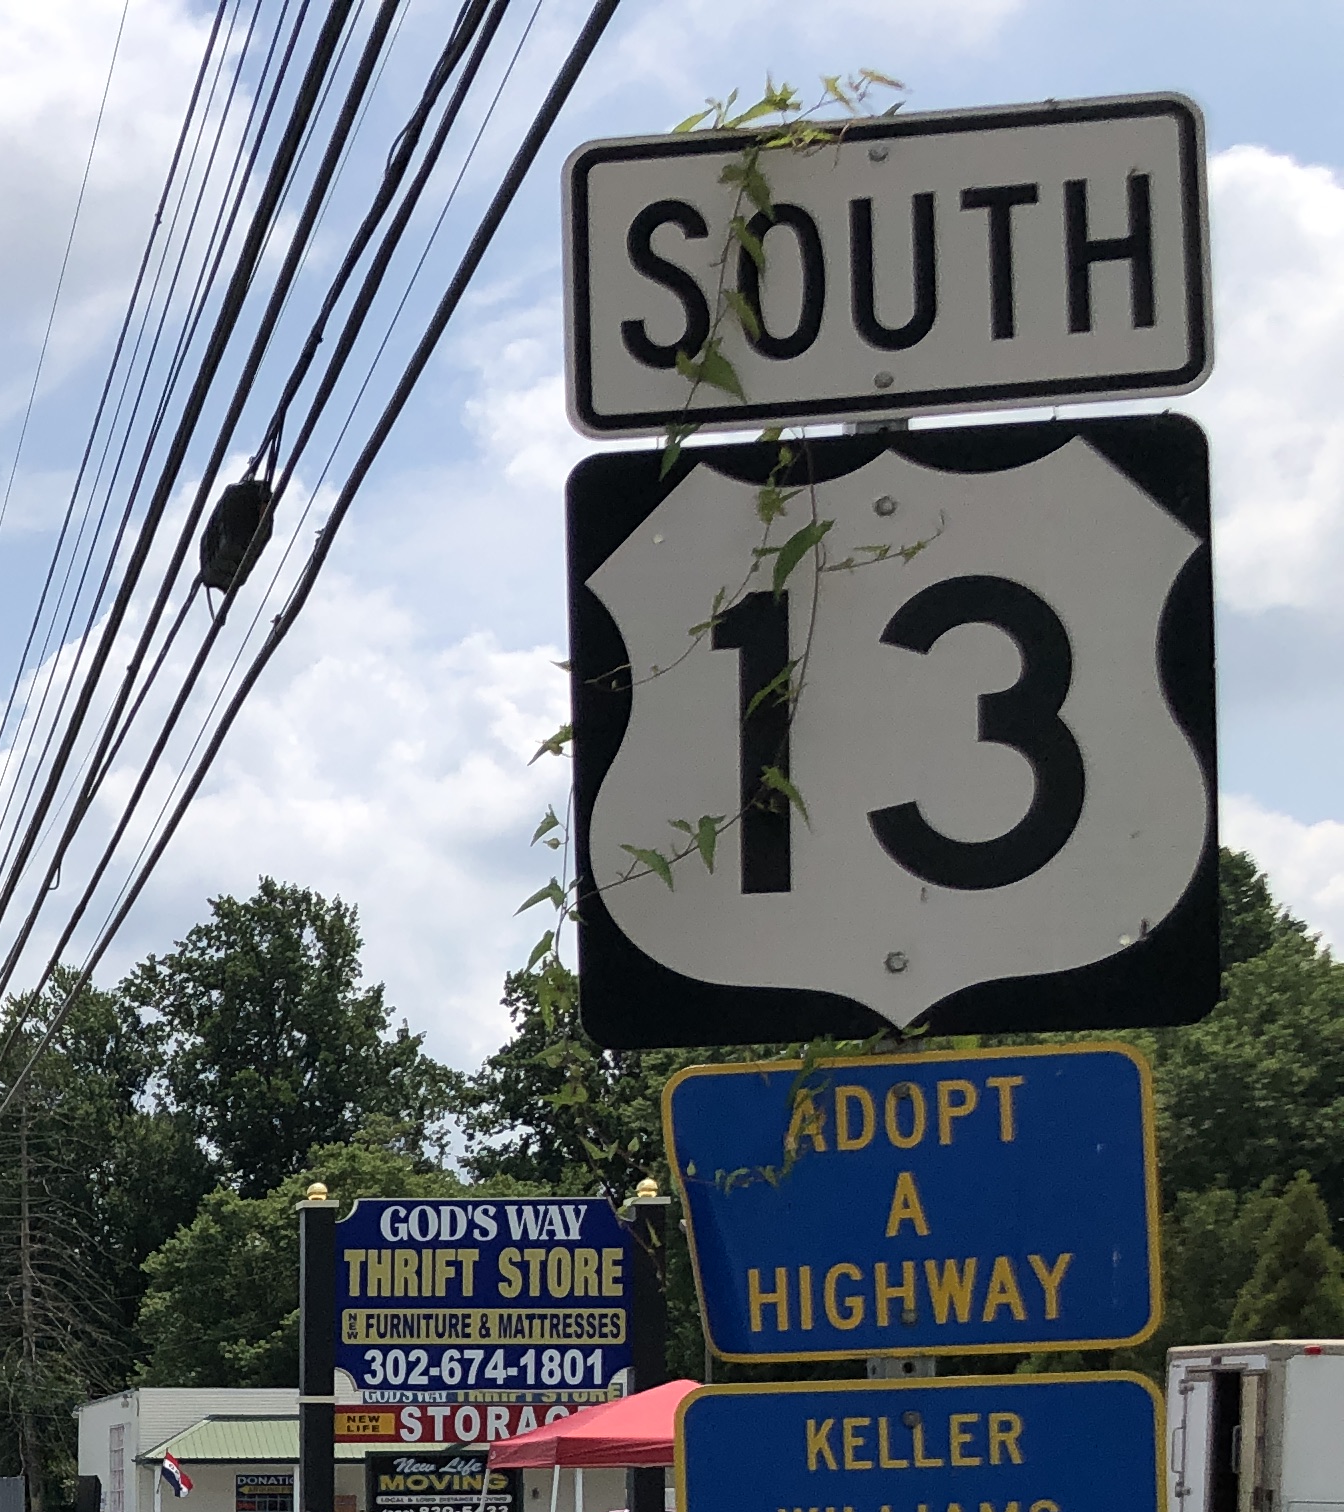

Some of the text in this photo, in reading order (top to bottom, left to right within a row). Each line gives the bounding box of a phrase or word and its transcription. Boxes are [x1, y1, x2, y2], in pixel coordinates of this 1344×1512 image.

[620, 172, 1157, 369] SOUTH
[711, 574, 1085, 894] 13
[786, 1075, 1025, 1152] ADOPT
[885, 1172, 930, 1237] A
[380, 1205, 587, 1241] GOD'S WAY
[344, 1247, 623, 1298] THRIFT STORE
[748, 1253, 1072, 1332] HIGHWAY
[347, 1313, 358, 1339] NEW
[365, 1312, 621, 1339] FURNITURE & MATTRESSES
[364, 1349, 603, 1385] 302-674-1801
[346, 1415, 380, 1423] NEW
[400, 1406, 593, 1441] STORA
[806, 1412, 1025, 1471] KELLER
[379, 1474, 509, 1491] MOVING
[393, 1457, 483, 1475] New Life
